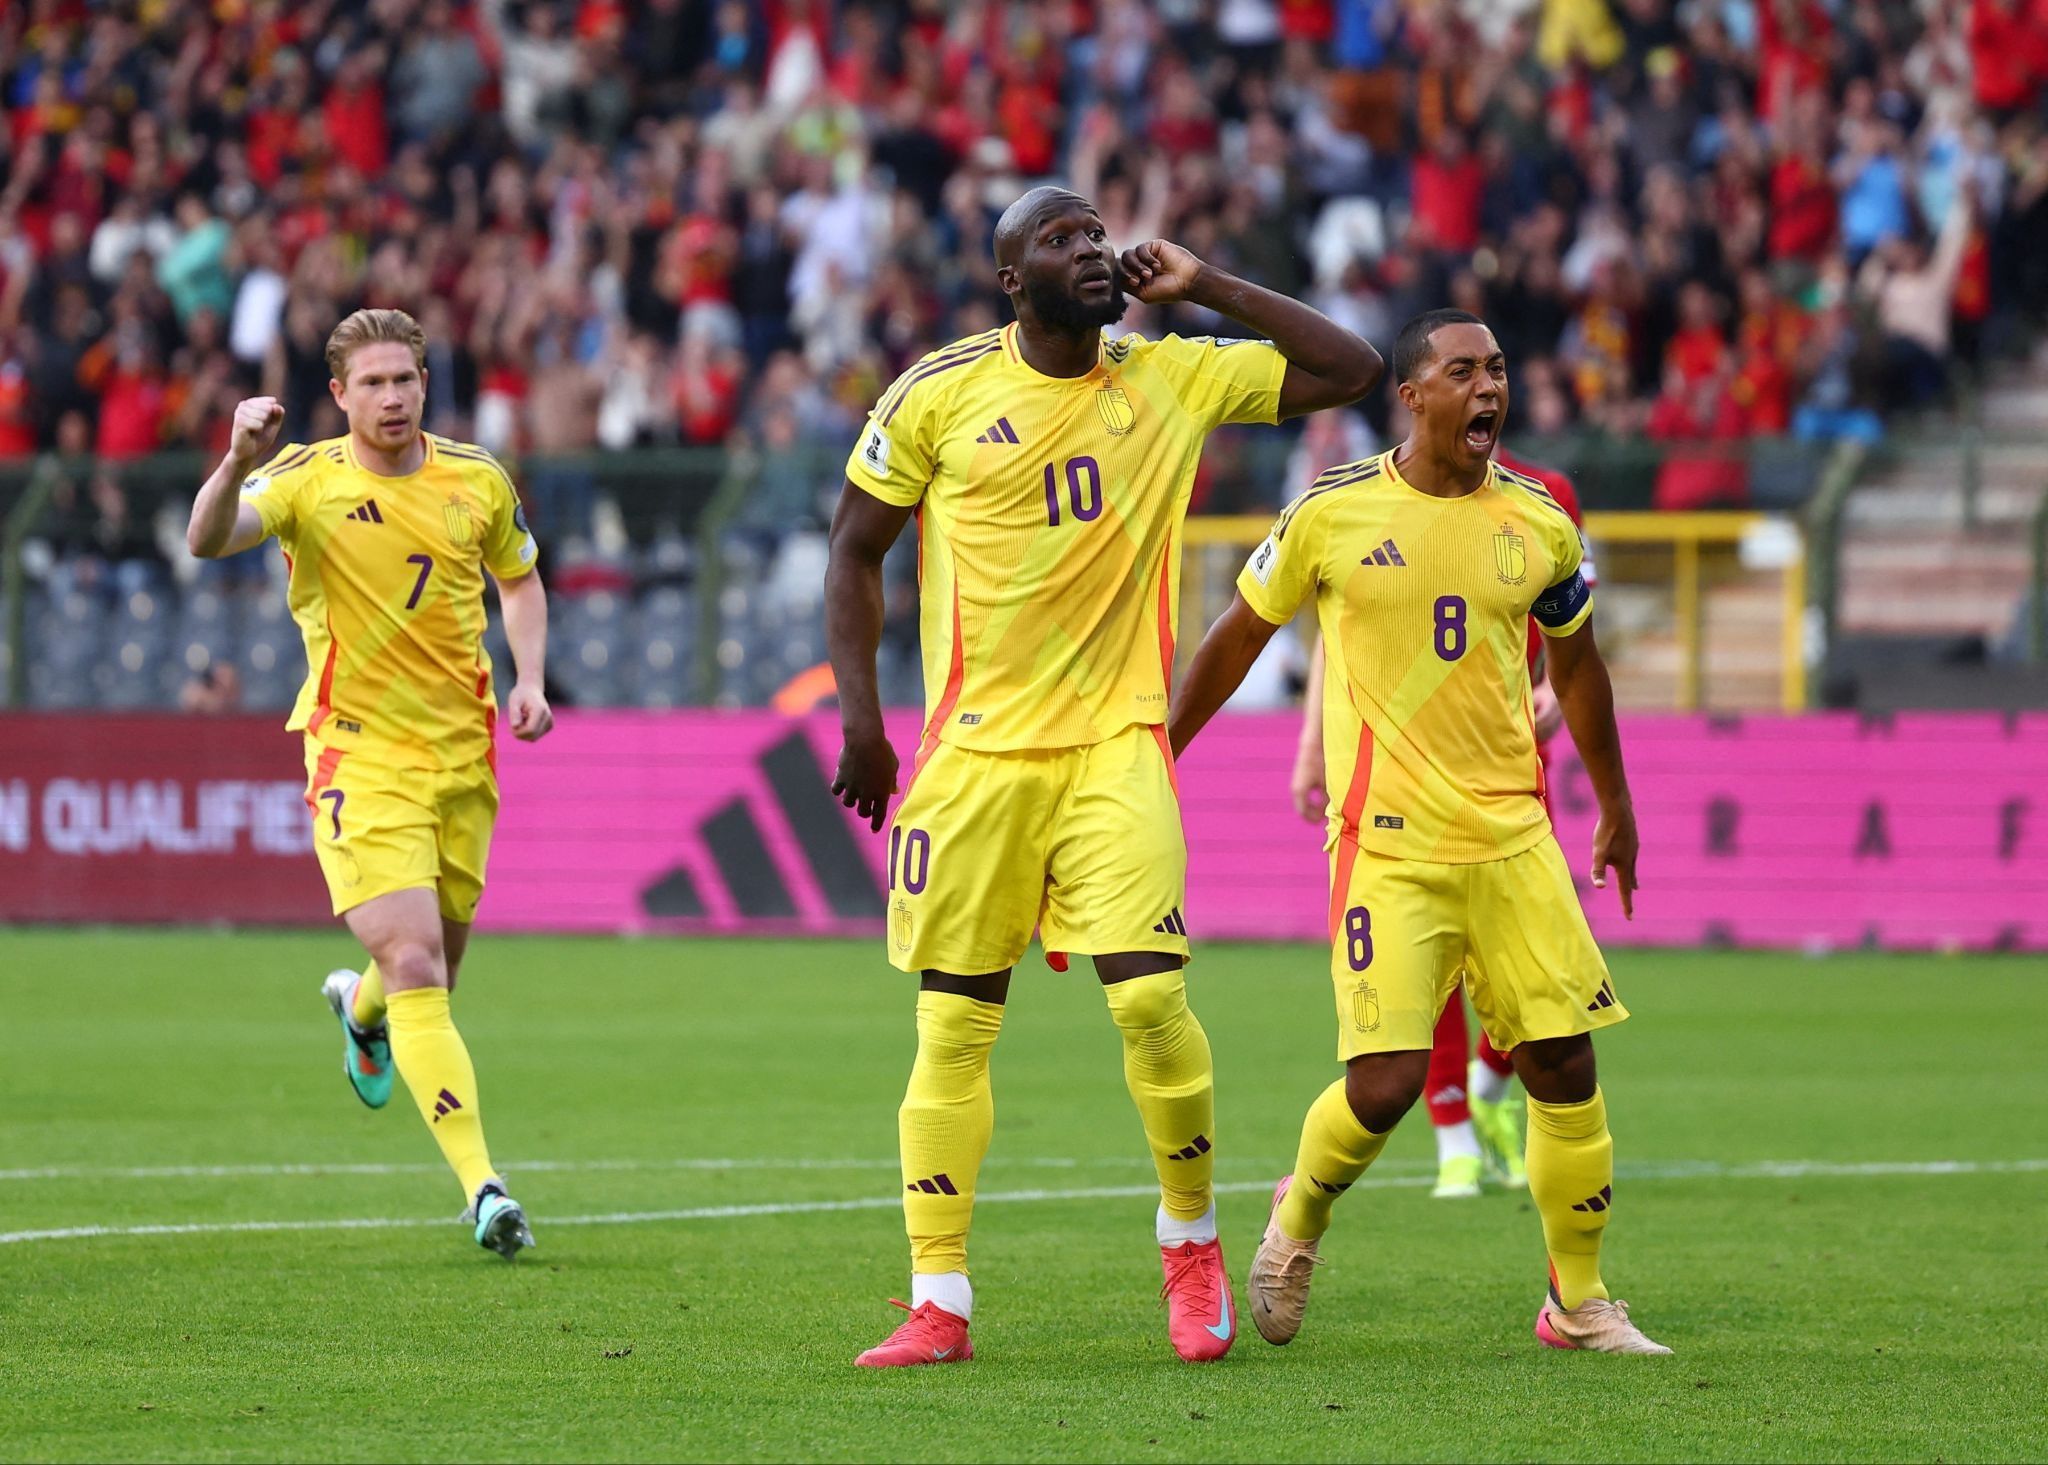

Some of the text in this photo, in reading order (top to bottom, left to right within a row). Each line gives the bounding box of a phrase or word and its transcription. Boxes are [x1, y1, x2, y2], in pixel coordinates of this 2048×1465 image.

[1044, 456, 1103, 526] 10
[405, 554, 433, 610] 7
[1434, 595, 1467, 661] 8
[43, 777, 315, 855] QUALIFIE
[320, 789, 345, 840] 7
[890, 825, 930, 895] 10
[1345, 906, 1374, 972] 8
